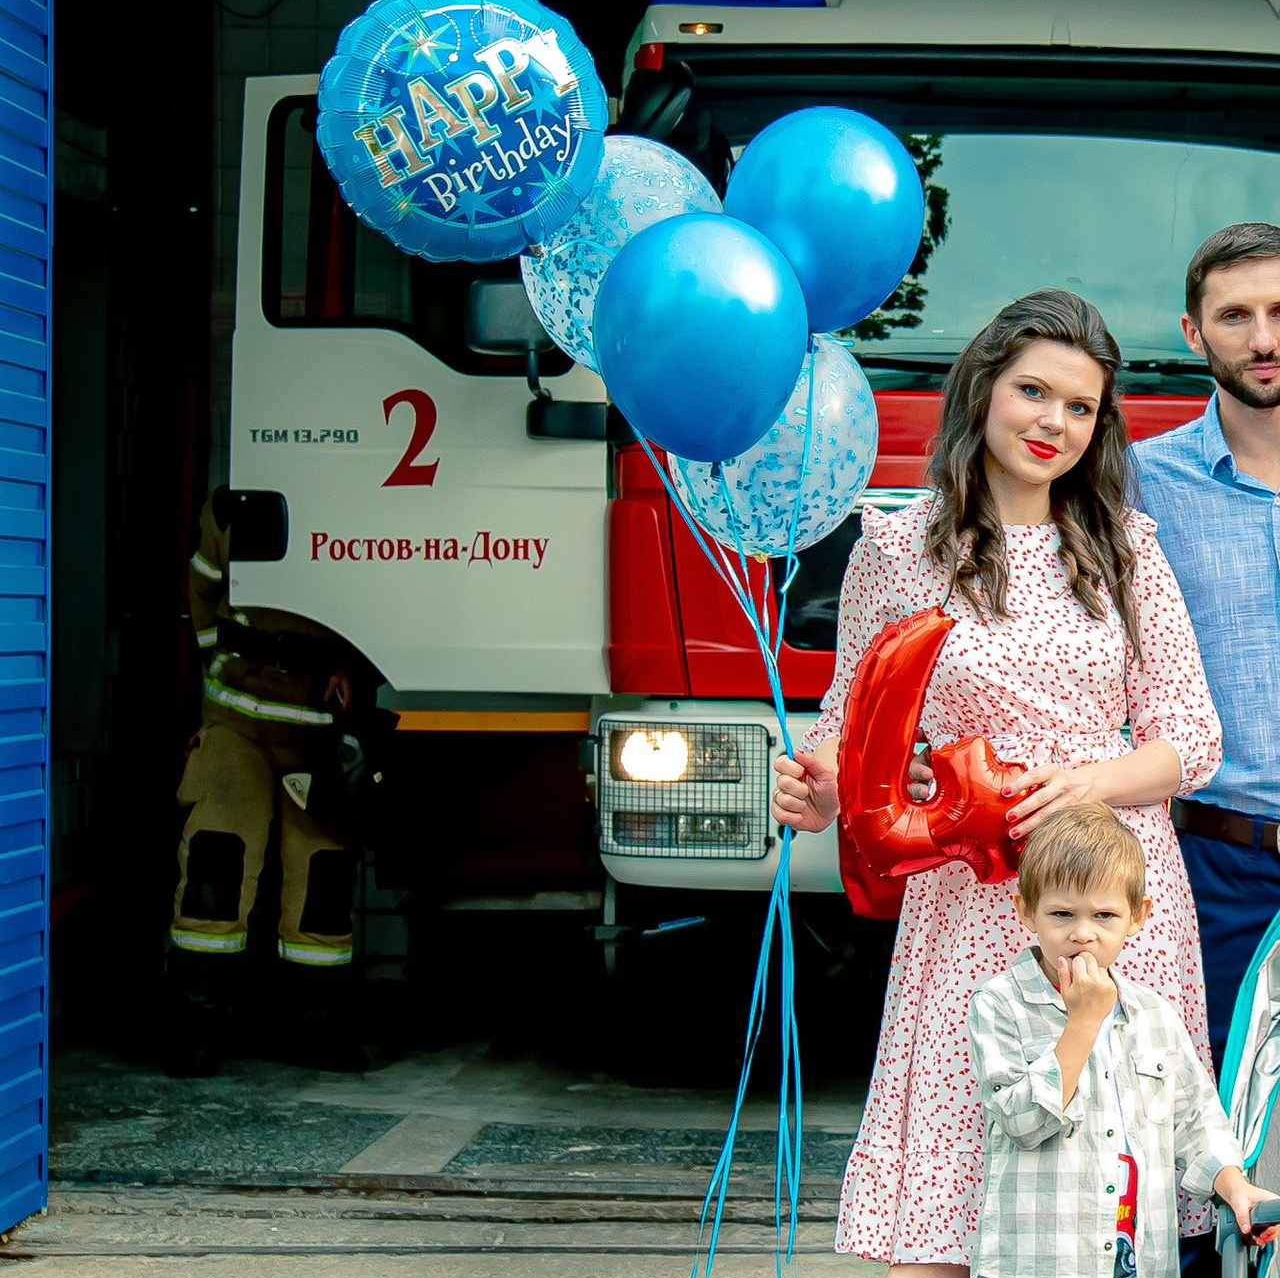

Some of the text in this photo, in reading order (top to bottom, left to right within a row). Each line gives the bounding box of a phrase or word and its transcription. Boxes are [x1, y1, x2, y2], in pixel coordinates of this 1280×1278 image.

[354, 28, 579, 188] HAPPY
[423, 114, 574, 213] Birthday
[249, 429, 288, 443] TGM
[381, 388, 440, 487] 2
[310, 531, 550, 569] Ростов-на-Дону
